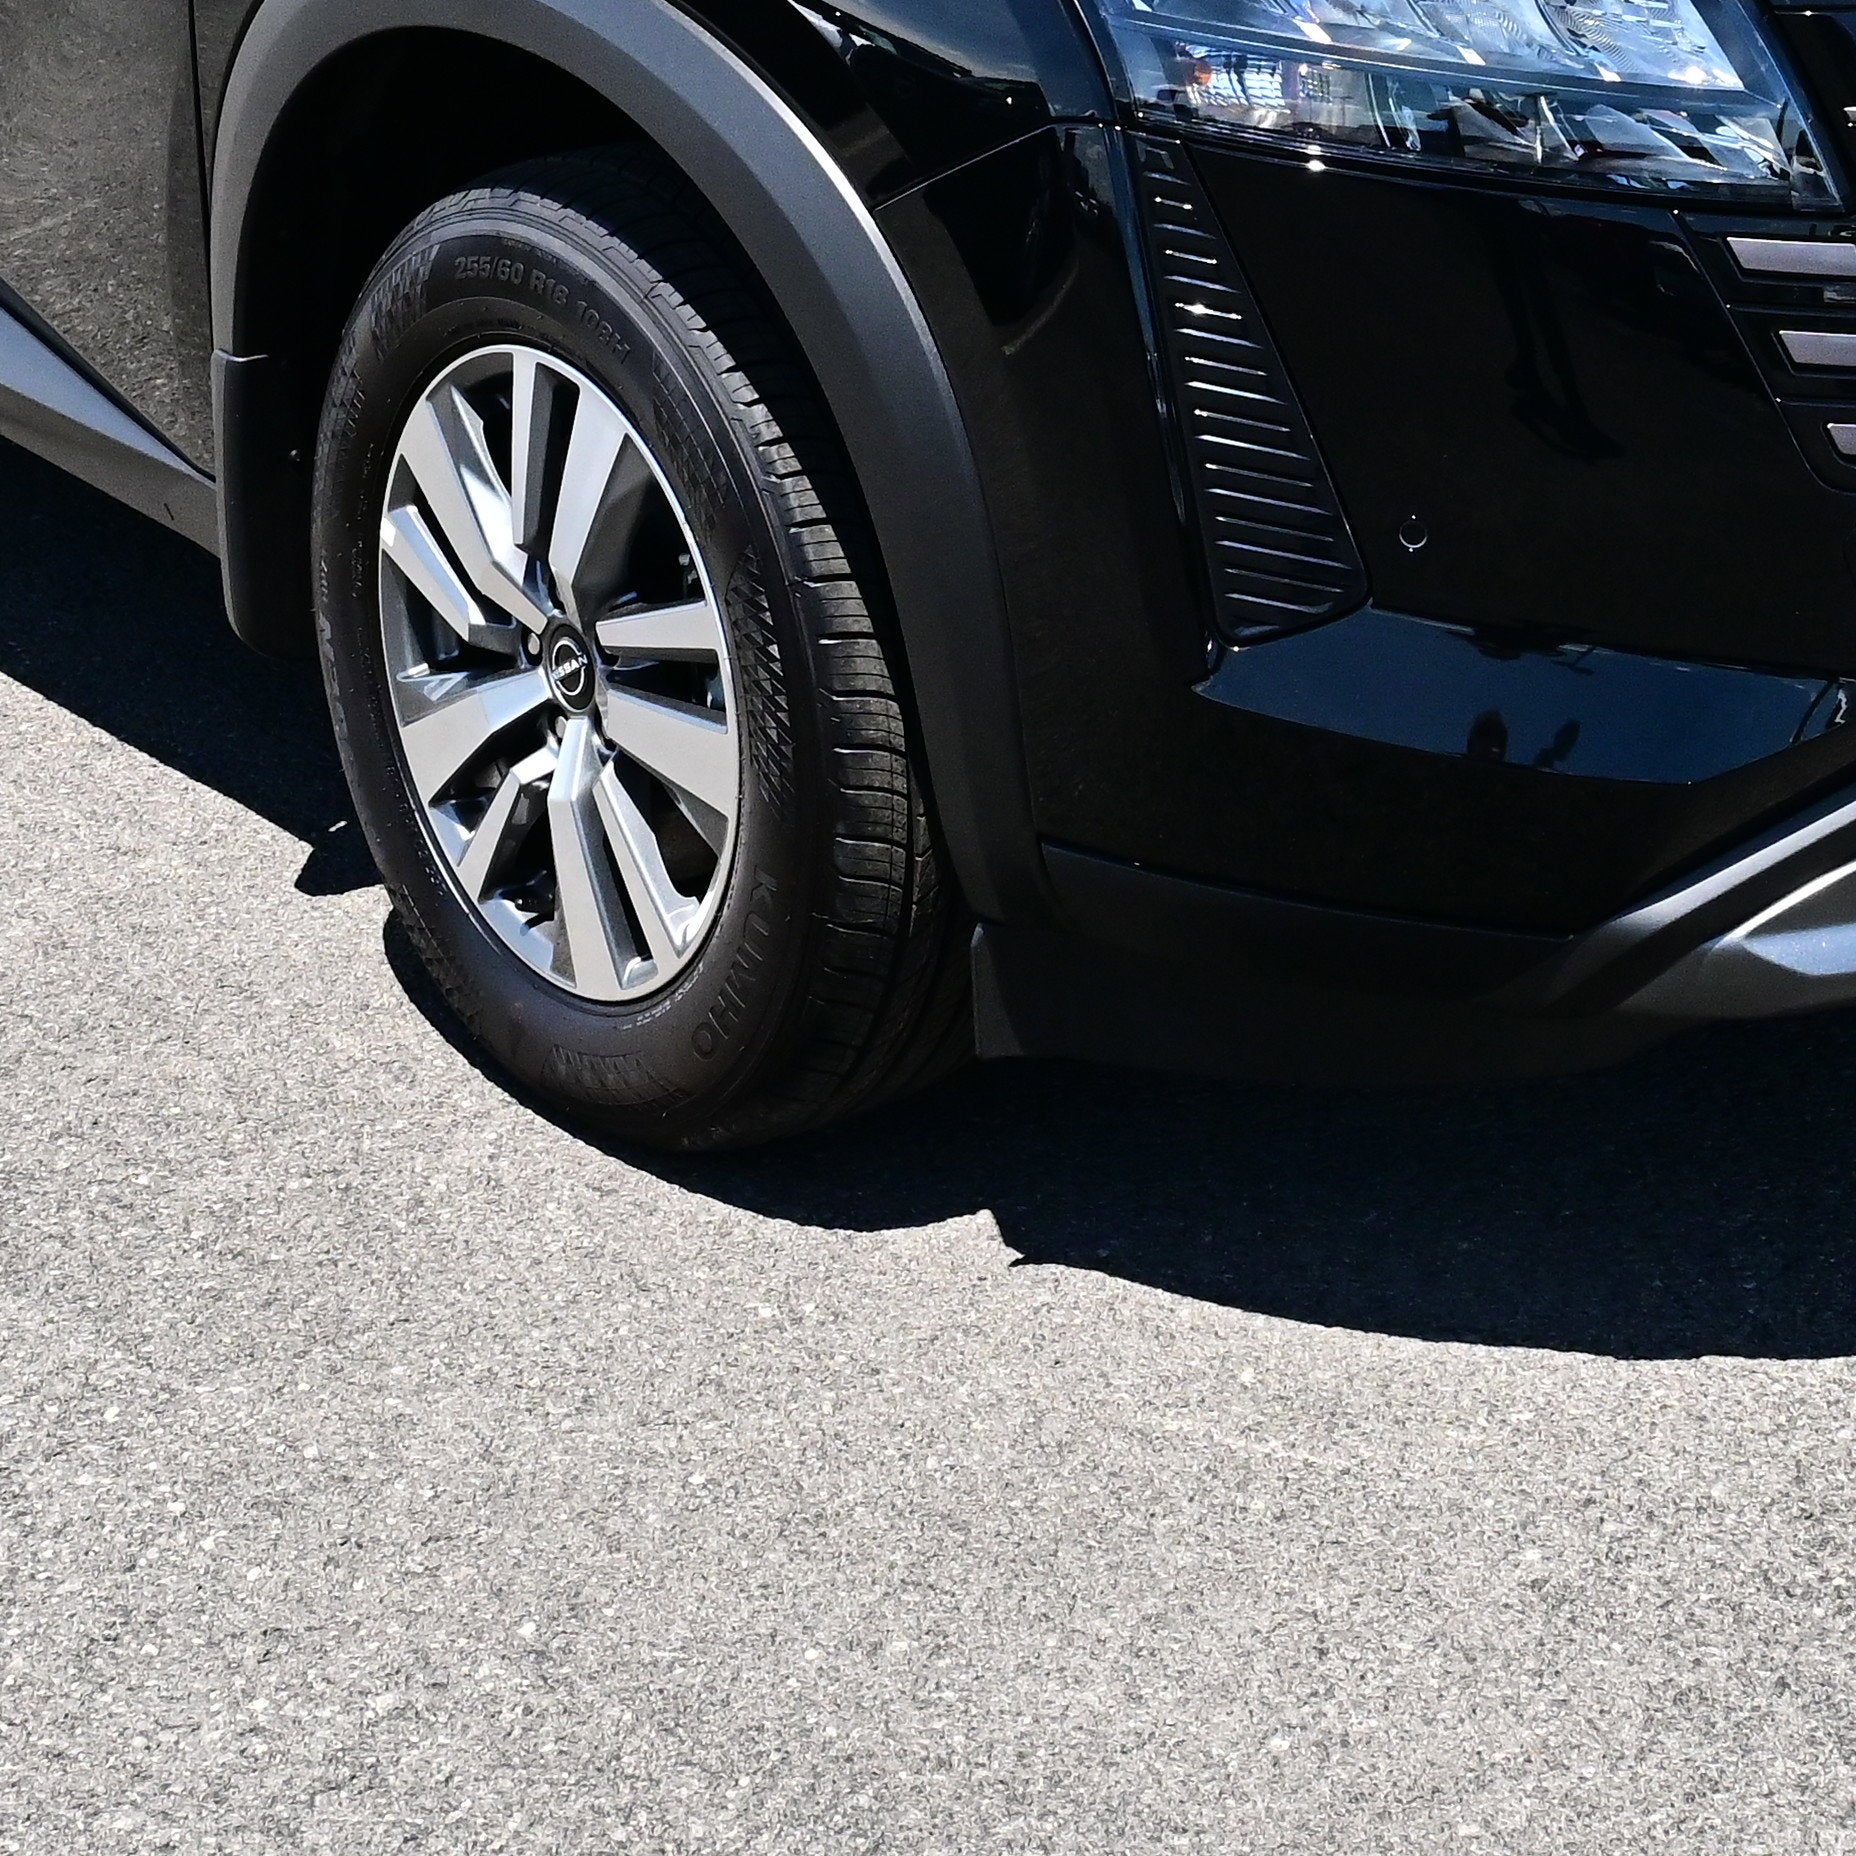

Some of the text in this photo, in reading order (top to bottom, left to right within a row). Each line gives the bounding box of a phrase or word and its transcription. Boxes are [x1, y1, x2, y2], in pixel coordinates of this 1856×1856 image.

[454, 256, 524, 285] 255/60
[529, 268, 570, 306] R18
[692, 864, 778, 1062] KUMHO
